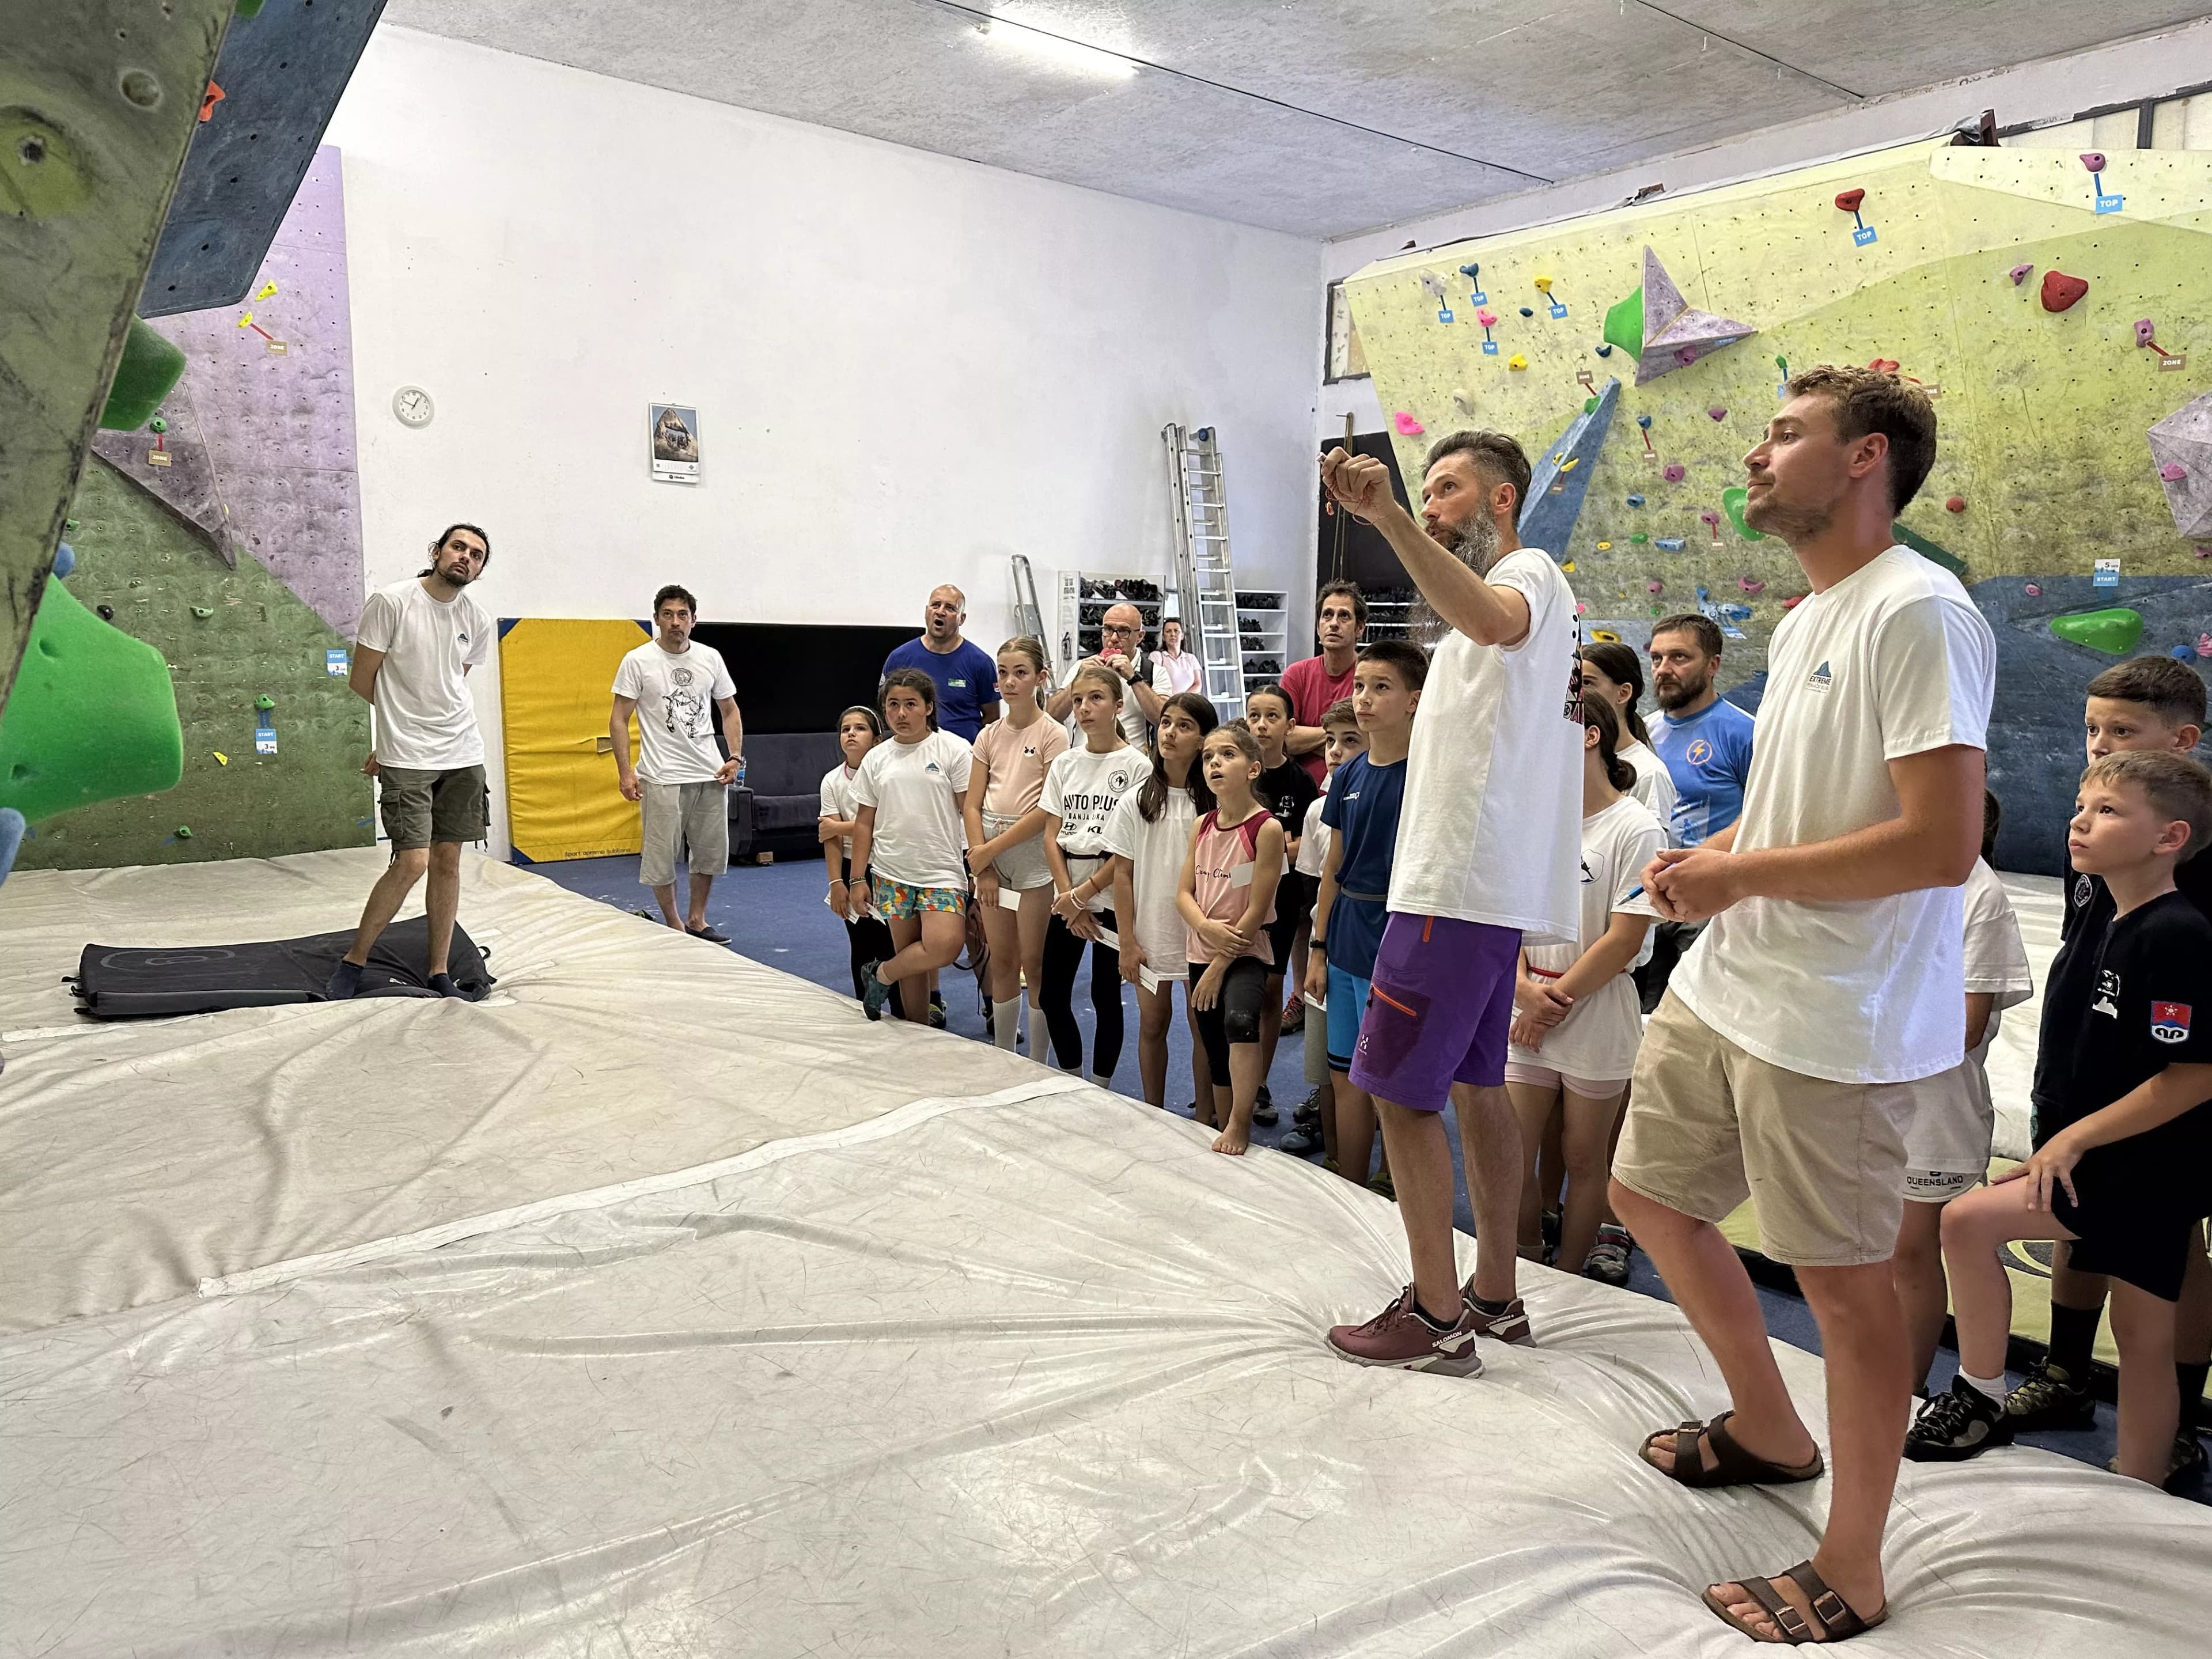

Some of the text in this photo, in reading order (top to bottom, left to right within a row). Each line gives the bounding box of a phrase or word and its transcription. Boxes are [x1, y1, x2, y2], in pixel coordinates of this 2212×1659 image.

[2100, 199, 2118, 207] TOP
[1857, 231, 1872, 241] TOP
[1809, 676, 1832, 685] EXTREME
[1068, 812, 1089, 821] BANJA
[1907, 1175, 1964, 1187] QUEENSLAND
[1431, 1330, 1463, 1348] SALOMON
